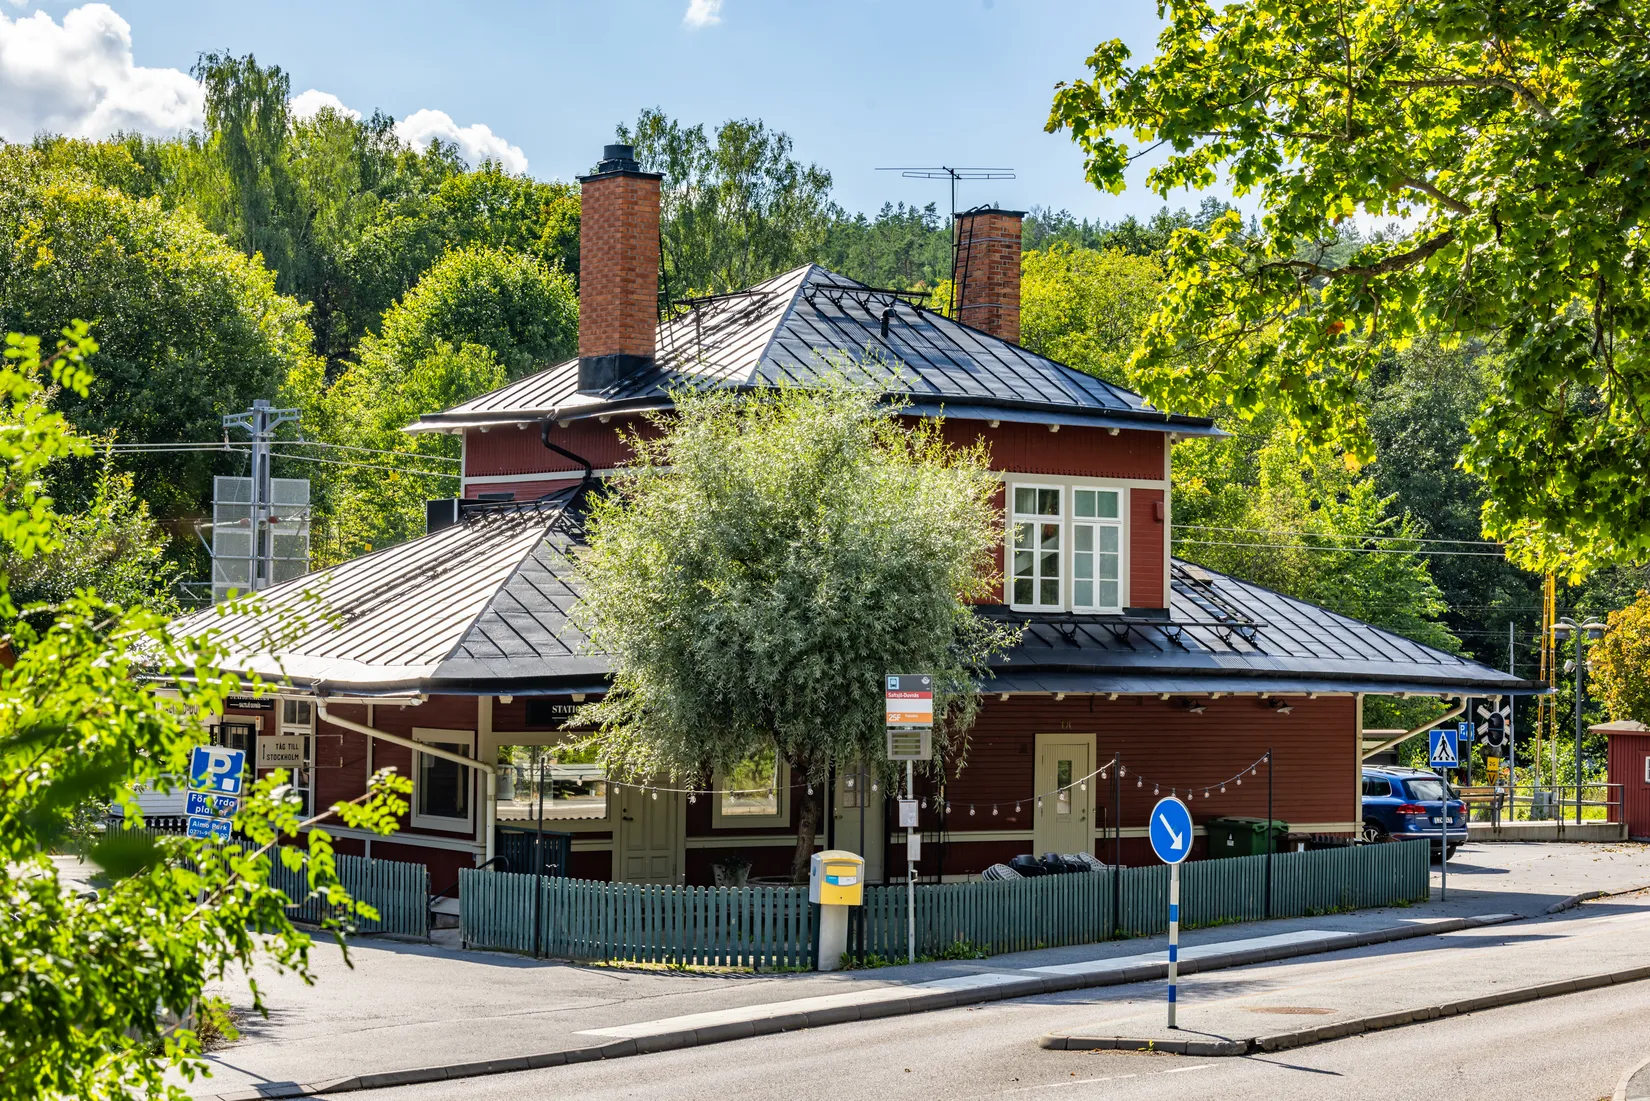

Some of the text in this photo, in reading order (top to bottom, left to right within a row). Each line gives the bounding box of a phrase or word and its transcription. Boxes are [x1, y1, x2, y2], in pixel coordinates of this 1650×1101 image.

[275, 742, 286, 750] TÅG
[266, 753, 299, 761] STOCKHOLM
[205, 751, 232, 787] P
[191, 794, 235, 807] Föryrda
[189, 828, 211, 836] 0771-9
